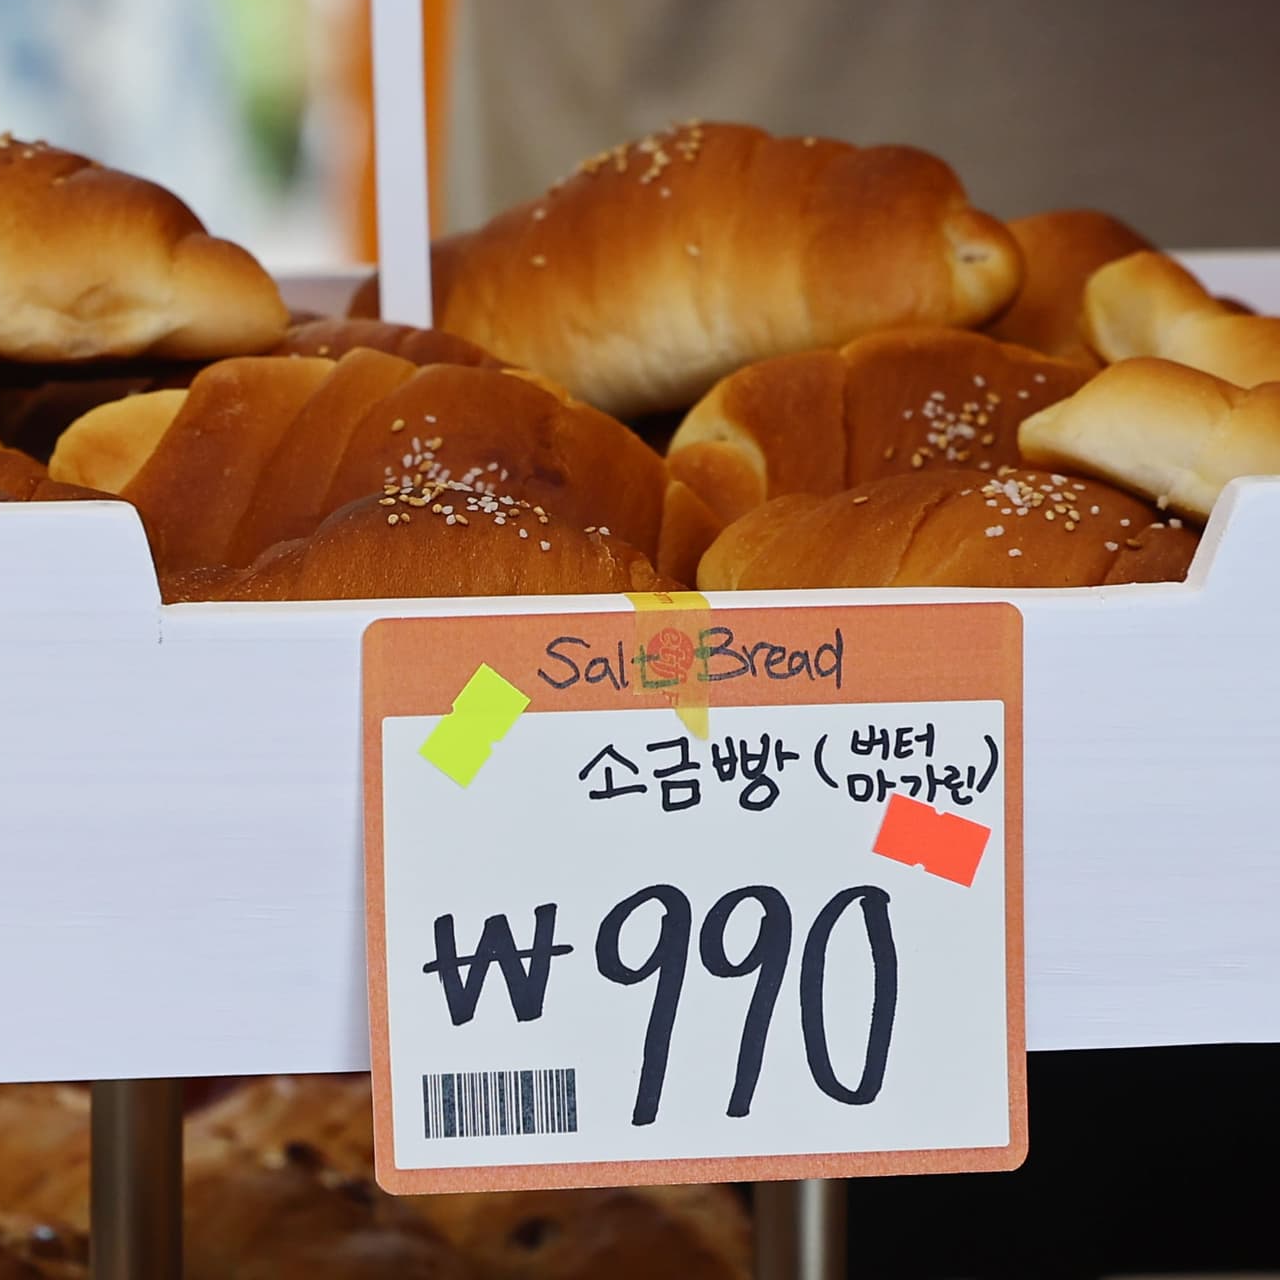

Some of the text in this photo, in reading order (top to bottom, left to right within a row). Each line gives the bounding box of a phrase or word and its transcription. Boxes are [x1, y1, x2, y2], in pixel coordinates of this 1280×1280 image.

[537, 626, 844, 691] Salt Bread
[578, 732, 800, 813] 소금빵
